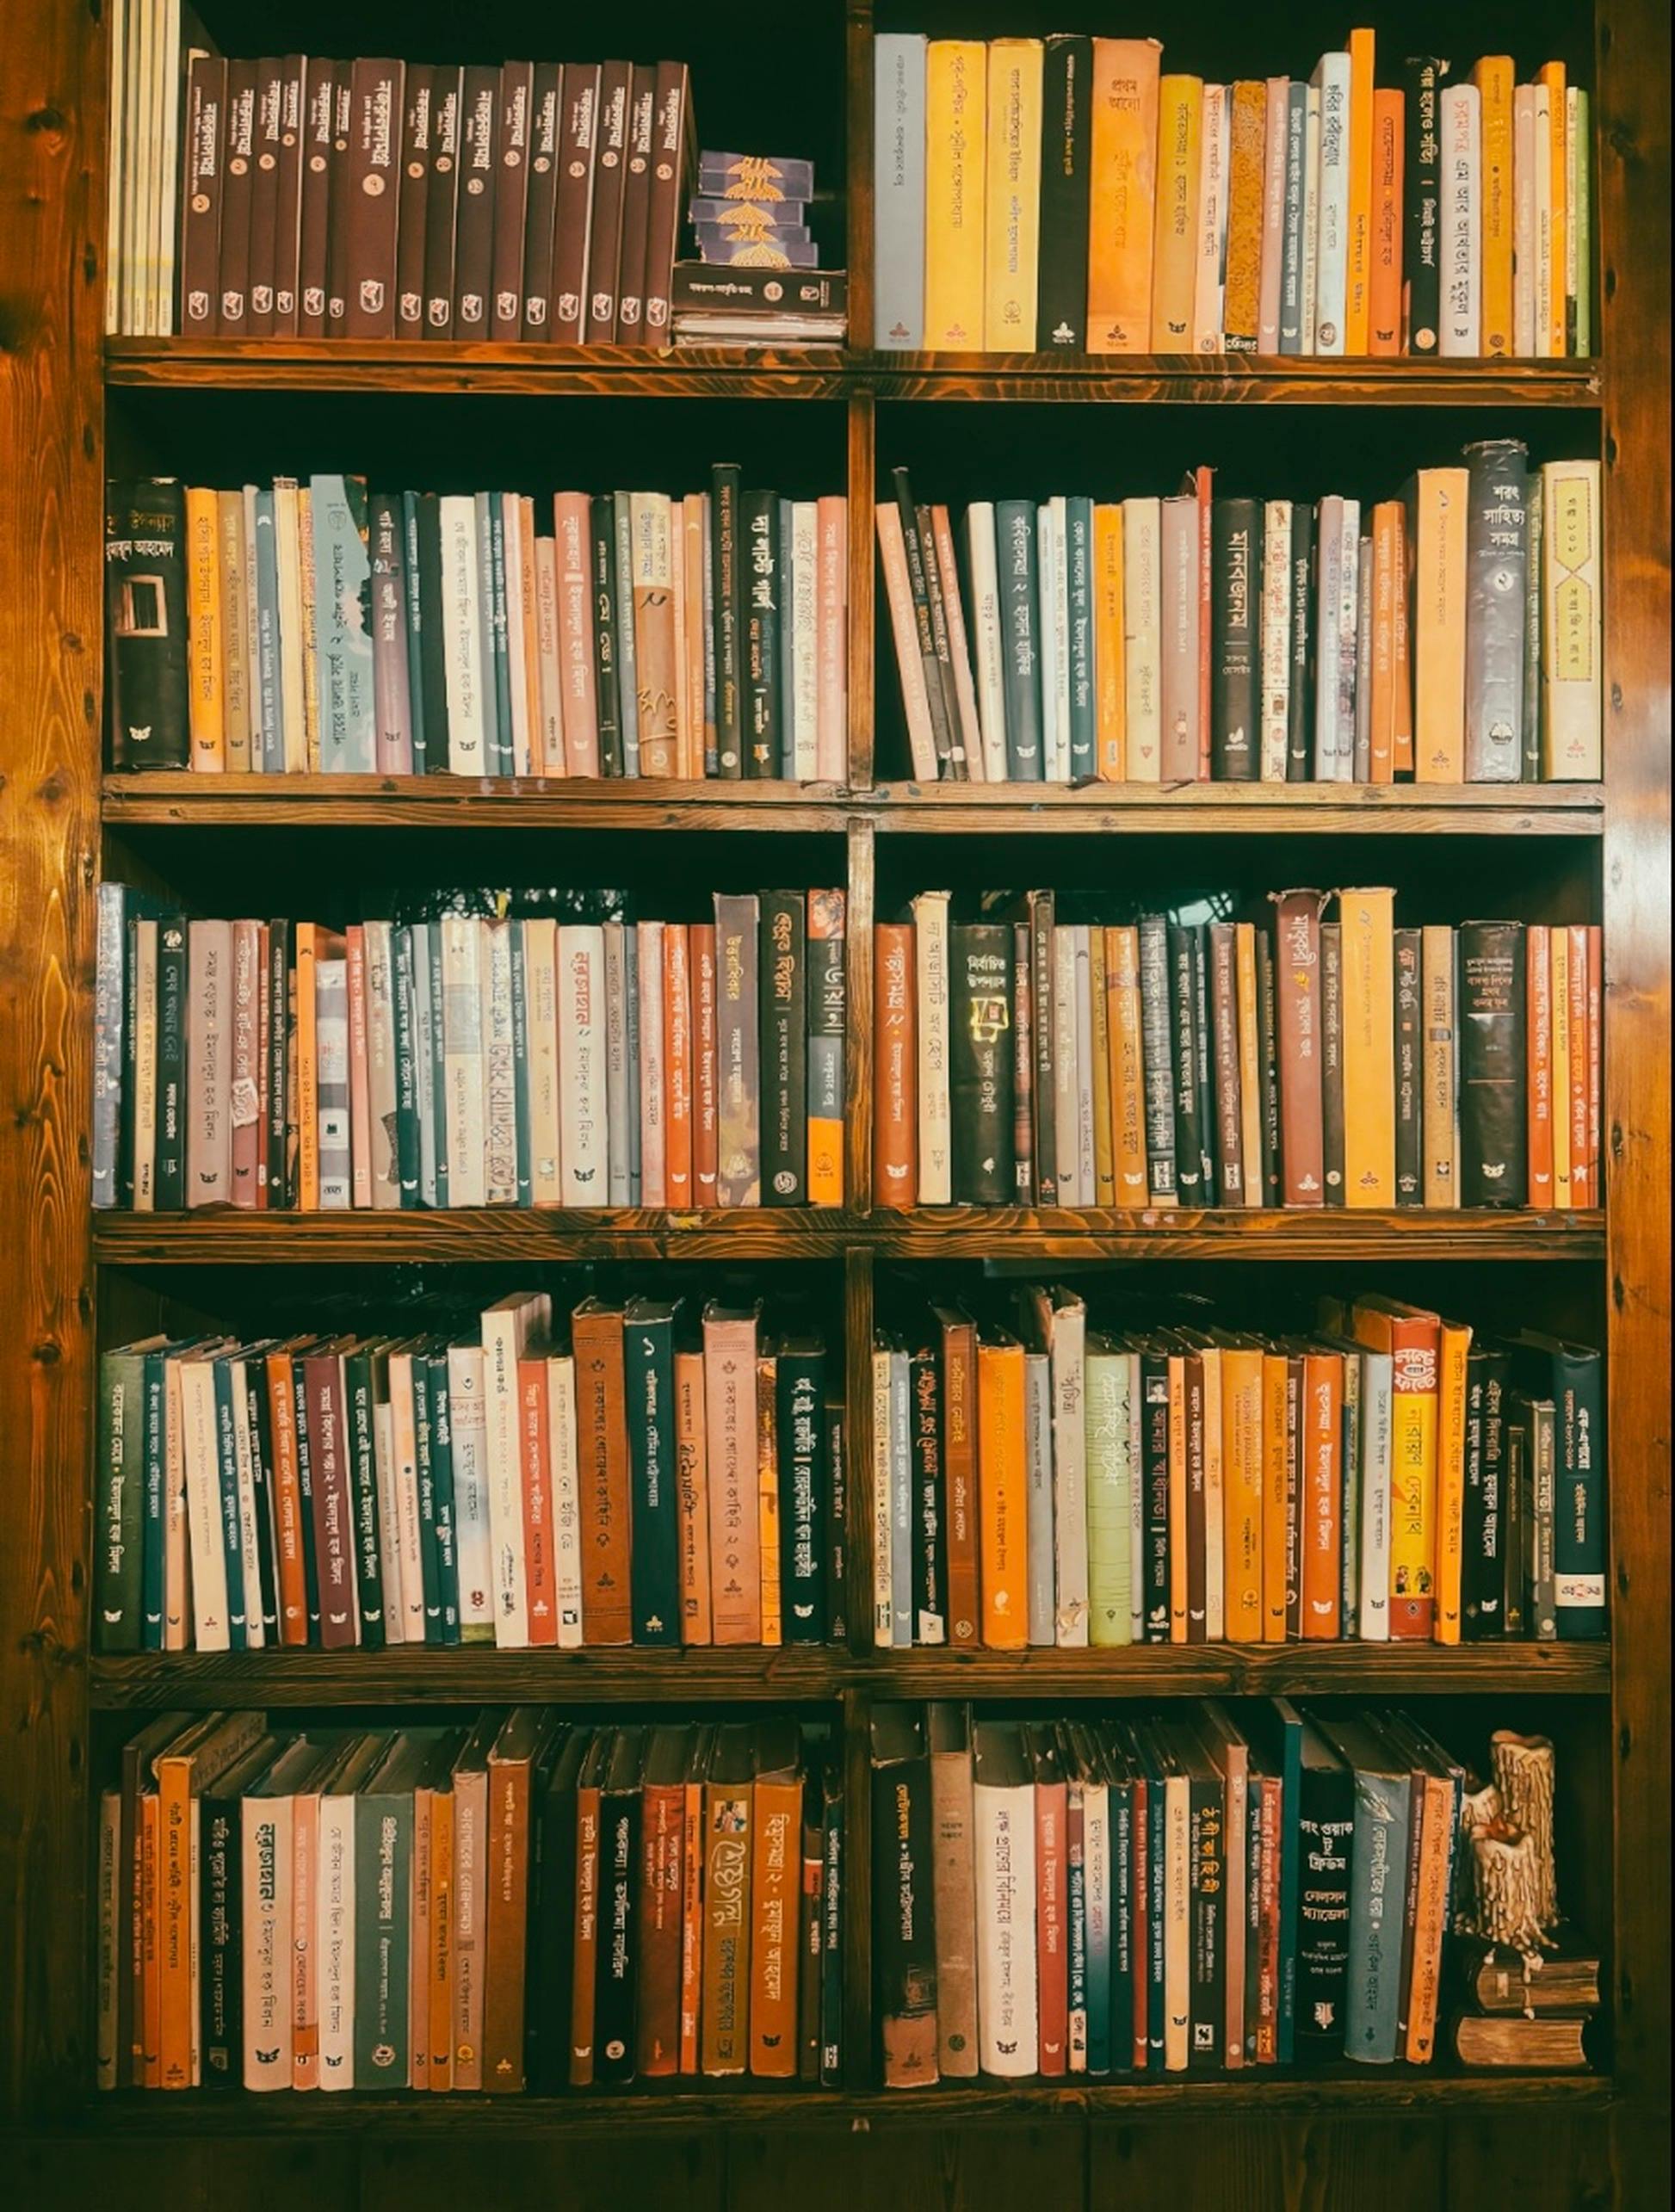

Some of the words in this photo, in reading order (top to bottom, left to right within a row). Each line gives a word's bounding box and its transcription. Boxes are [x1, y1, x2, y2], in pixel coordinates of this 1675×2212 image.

[1419, 92, 1435, 129] হলেও
[1455, 101, 1470, 153] চরমপত্র
[950, 130, 965, 159] সুনীল
[1456, 159, 1469, 181] এম
[1456, 187, 1469, 213] আর
[1456, 219, 1469, 275] আখতার
[1449, 281, 1469, 314] মুকুল
[1482, 504, 1525, 526] সাহিত্য
[562, 517, 580, 570] নূরজাহান
[751, 538, 773, 573] লাস্ট
[1227, 530, 1249, 627] মানবজনম
[567, 585, 584, 634] ইমদাদুল
[1016, 605, 1031, 636] হাসান
[570, 640, 584, 660] হক
[1017, 640, 1035, 676] হাফিজ
[572, 664, 588, 697] মিলন
[1288, 914, 1313, 966] মাধুকরী
[726, 936, 742, 1000] উত্তরাধিকার
[572, 952, 590, 1026] নূরজাহান
[732, 1029, 741, 1062] সমরেশ
[578, 1097, 590, 1115] হক
[578, 1121, 593, 1150] মিলন
[593, 1381, 606, 1431] সেকালের
[725, 1381, 737, 1432] সেকালের
[1486, 1380, 1501, 1413] এইসব
[320, 1414, 336, 1450] কিশোর
[1151, 1409, 1166, 1453] আমার
[1406, 1410, 1424, 1465] নারায়ণ
[1316, 1443, 1332, 1492] ইমদাদুল
[108, 1476, 123, 1519] ইমদাদুল
[596, 1487, 610, 1527] কাহিনি
[726, 1488, 742, 1527] কাহিনি
[1152, 1460, 1170, 1519] স্বাধীনতা
[1319, 1497, 1331, 1515] হক
[1405, 1476, 1424, 1535] দেবনাথ
[1483, 1474, 1498, 1510] হুমায়ূন
[110, 1523, 122, 1542] হক
[328, 1539, 340, 1554] হক
[726, 1536, 738, 1546] ২
[1318, 1519, 1334, 1549] মিলন
[1483, 1514, 1499, 1556] আহমেদ
[108, 1546, 123, 1573] মিলন
[329, 1559, 343, 1584] মিলন
[459, 1808, 473, 1869] কারাগারের
[255, 1824, 275, 1902] নূরজাহান
[458, 1874, 473, 1934] রোজনামচা
[613, 1882, 628, 1929] তসলিমা
[996, 1876, 1014, 1925] বিনিময়ে
[763, 1900, 782, 1943] হুমায়ূন
[1047, 1925, 1059, 1953] মিলন
[258, 1919, 275, 1966] ইমদাদুল
[612, 1934, 627, 1978] নাসরিন
[261, 1972, 274, 1991] হক
[763, 1947, 782, 2000] আহমেদ
[261, 1995, 276, 2027] মিলন
[1364, 1976, 1379, 2011] আহমদ
